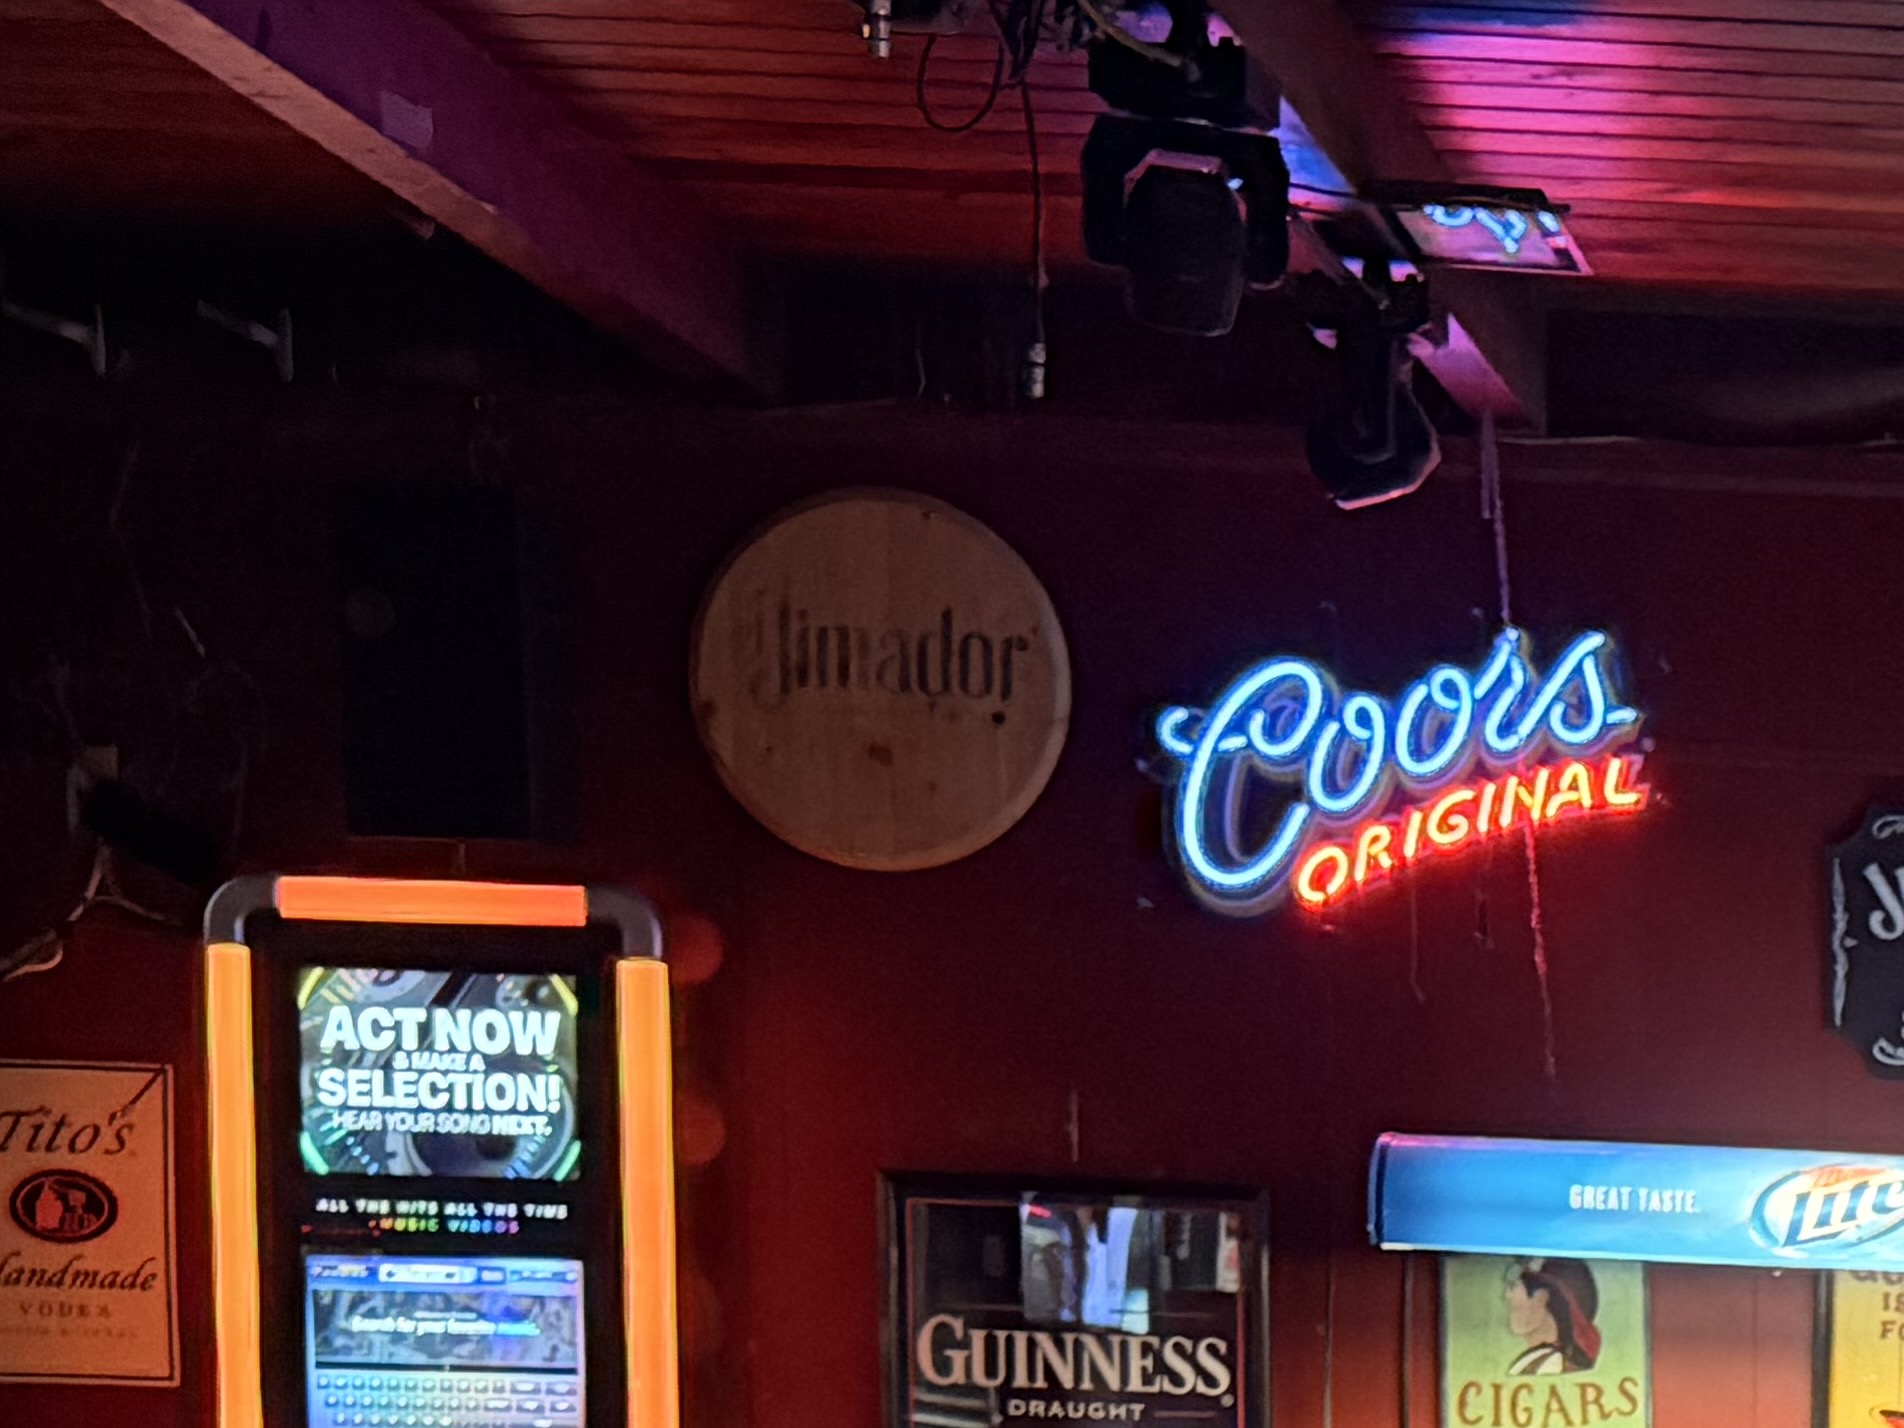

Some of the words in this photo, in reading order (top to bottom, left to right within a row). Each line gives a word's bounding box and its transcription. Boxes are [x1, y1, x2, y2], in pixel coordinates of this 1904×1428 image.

[1158, 628, 1640, 898] Coors
[1294, 756, 1648, 910] ORIGINAL
[320, 1005, 427, 1052] ACT
[434, 1008, 561, 1055] NOW
[411, 1052, 467, 1071] MAKE
[469, 1053, 486, 1072] A
[317, 1068, 561, 1114] SELECTION!
[0, 1105, 136, 1157] Tito's
[331, 1110, 384, 1132] HEAR
[384, 1111, 436, 1134] YOUR
[436, 1113, 492, 1135] SONG
[316, 1198, 349, 1213] ALL
[444, 1202, 478, 1217] ALL
[1569, 1184, 1632, 1211] GREAT
[447, 1219, 519, 1234] VIDEOS
[917, 1314, 1231, 1397] GUINNESS
[1008, 1400, 1146, 1422] DRAUGHT
[1457, 1377, 1640, 1428] CIGARS
